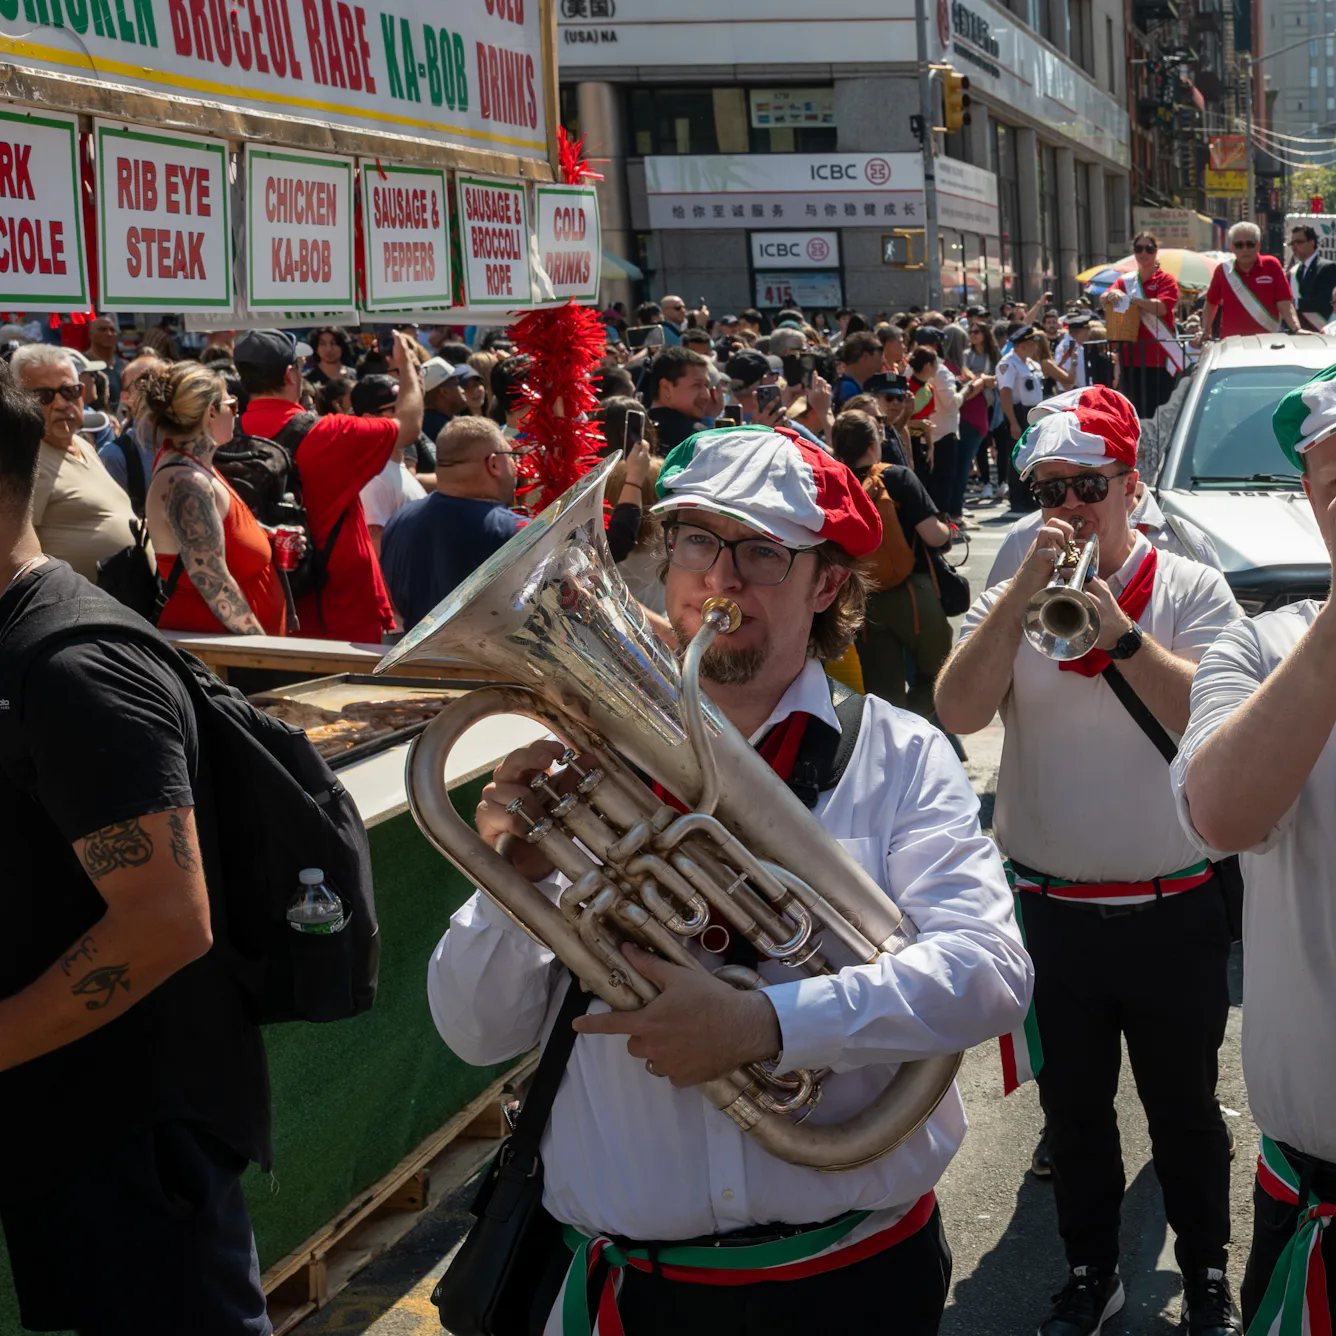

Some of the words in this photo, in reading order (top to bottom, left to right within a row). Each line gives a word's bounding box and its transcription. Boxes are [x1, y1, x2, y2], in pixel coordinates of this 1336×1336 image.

[564, 29, 599, 44] (USA)
[601, 30, 617, 43] NA
[302, 0, 377, 94] RABE
[380, 12, 468, 112] KA-BOB
[476, 41, 537, 130] DRINKS
[117, 156, 158, 212] RIB
[165, 163, 211, 218] EYE
[811, 164, 858, 180] ICBC
[265, 176, 337, 227] CHICKEN
[373, 186, 429, 230] SAUSAGE
[431, 190, 440, 230] &
[465, 187, 511, 224] SAUSAGE
[514, 193, 522, 225] &
[672, 204, 784, 219] 给你至诚服务
[804, 202, 916, 217] 与你稳健成长
[553, 206, 586, 242] COLD
[126, 225, 207, 280] STEAK
[272, 237, 331, 283] KA-BOB
[471, 226, 521, 260] BROCCOLI
[760, 243, 801, 257] ICBC
[383, 241, 435, 283] PEPPERS
[485, 263, 512, 295] ROPE
[545, 251, 591, 285] DRINKS
[765, 286, 793, 304] 415
